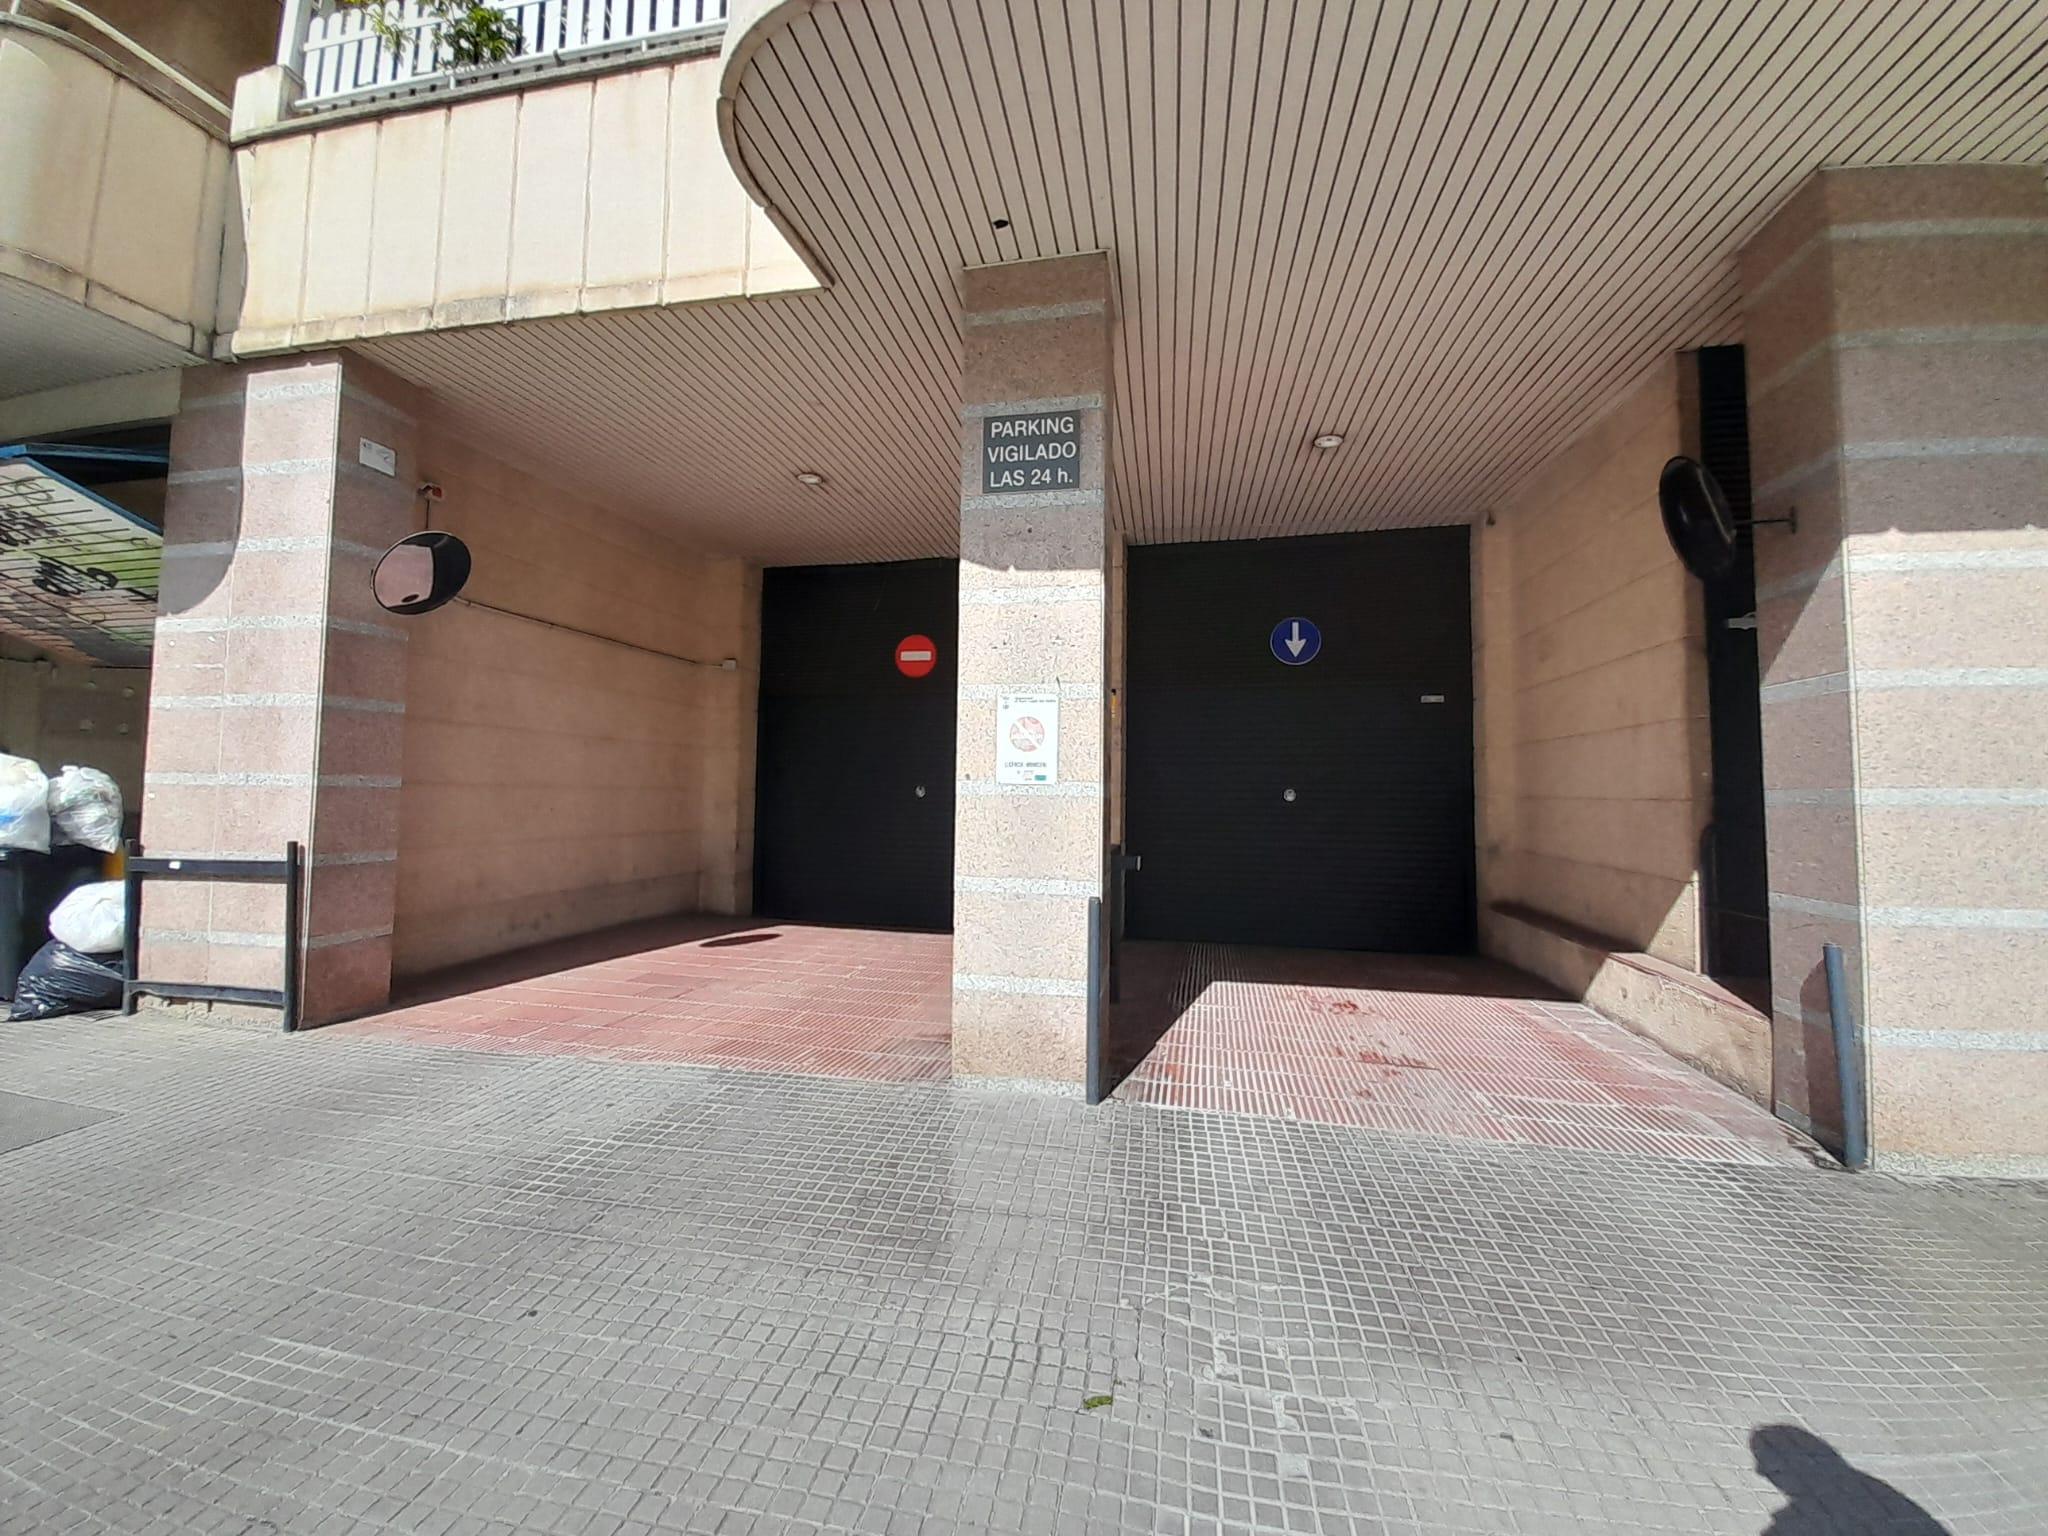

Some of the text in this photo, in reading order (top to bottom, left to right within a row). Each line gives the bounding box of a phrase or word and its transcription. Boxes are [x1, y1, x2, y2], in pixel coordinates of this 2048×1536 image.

[991, 416, 1074, 438] PARKING
[987, 441, 1077, 463] VIGILADO
[990, 467, 1073, 488] LAS 24 h.
